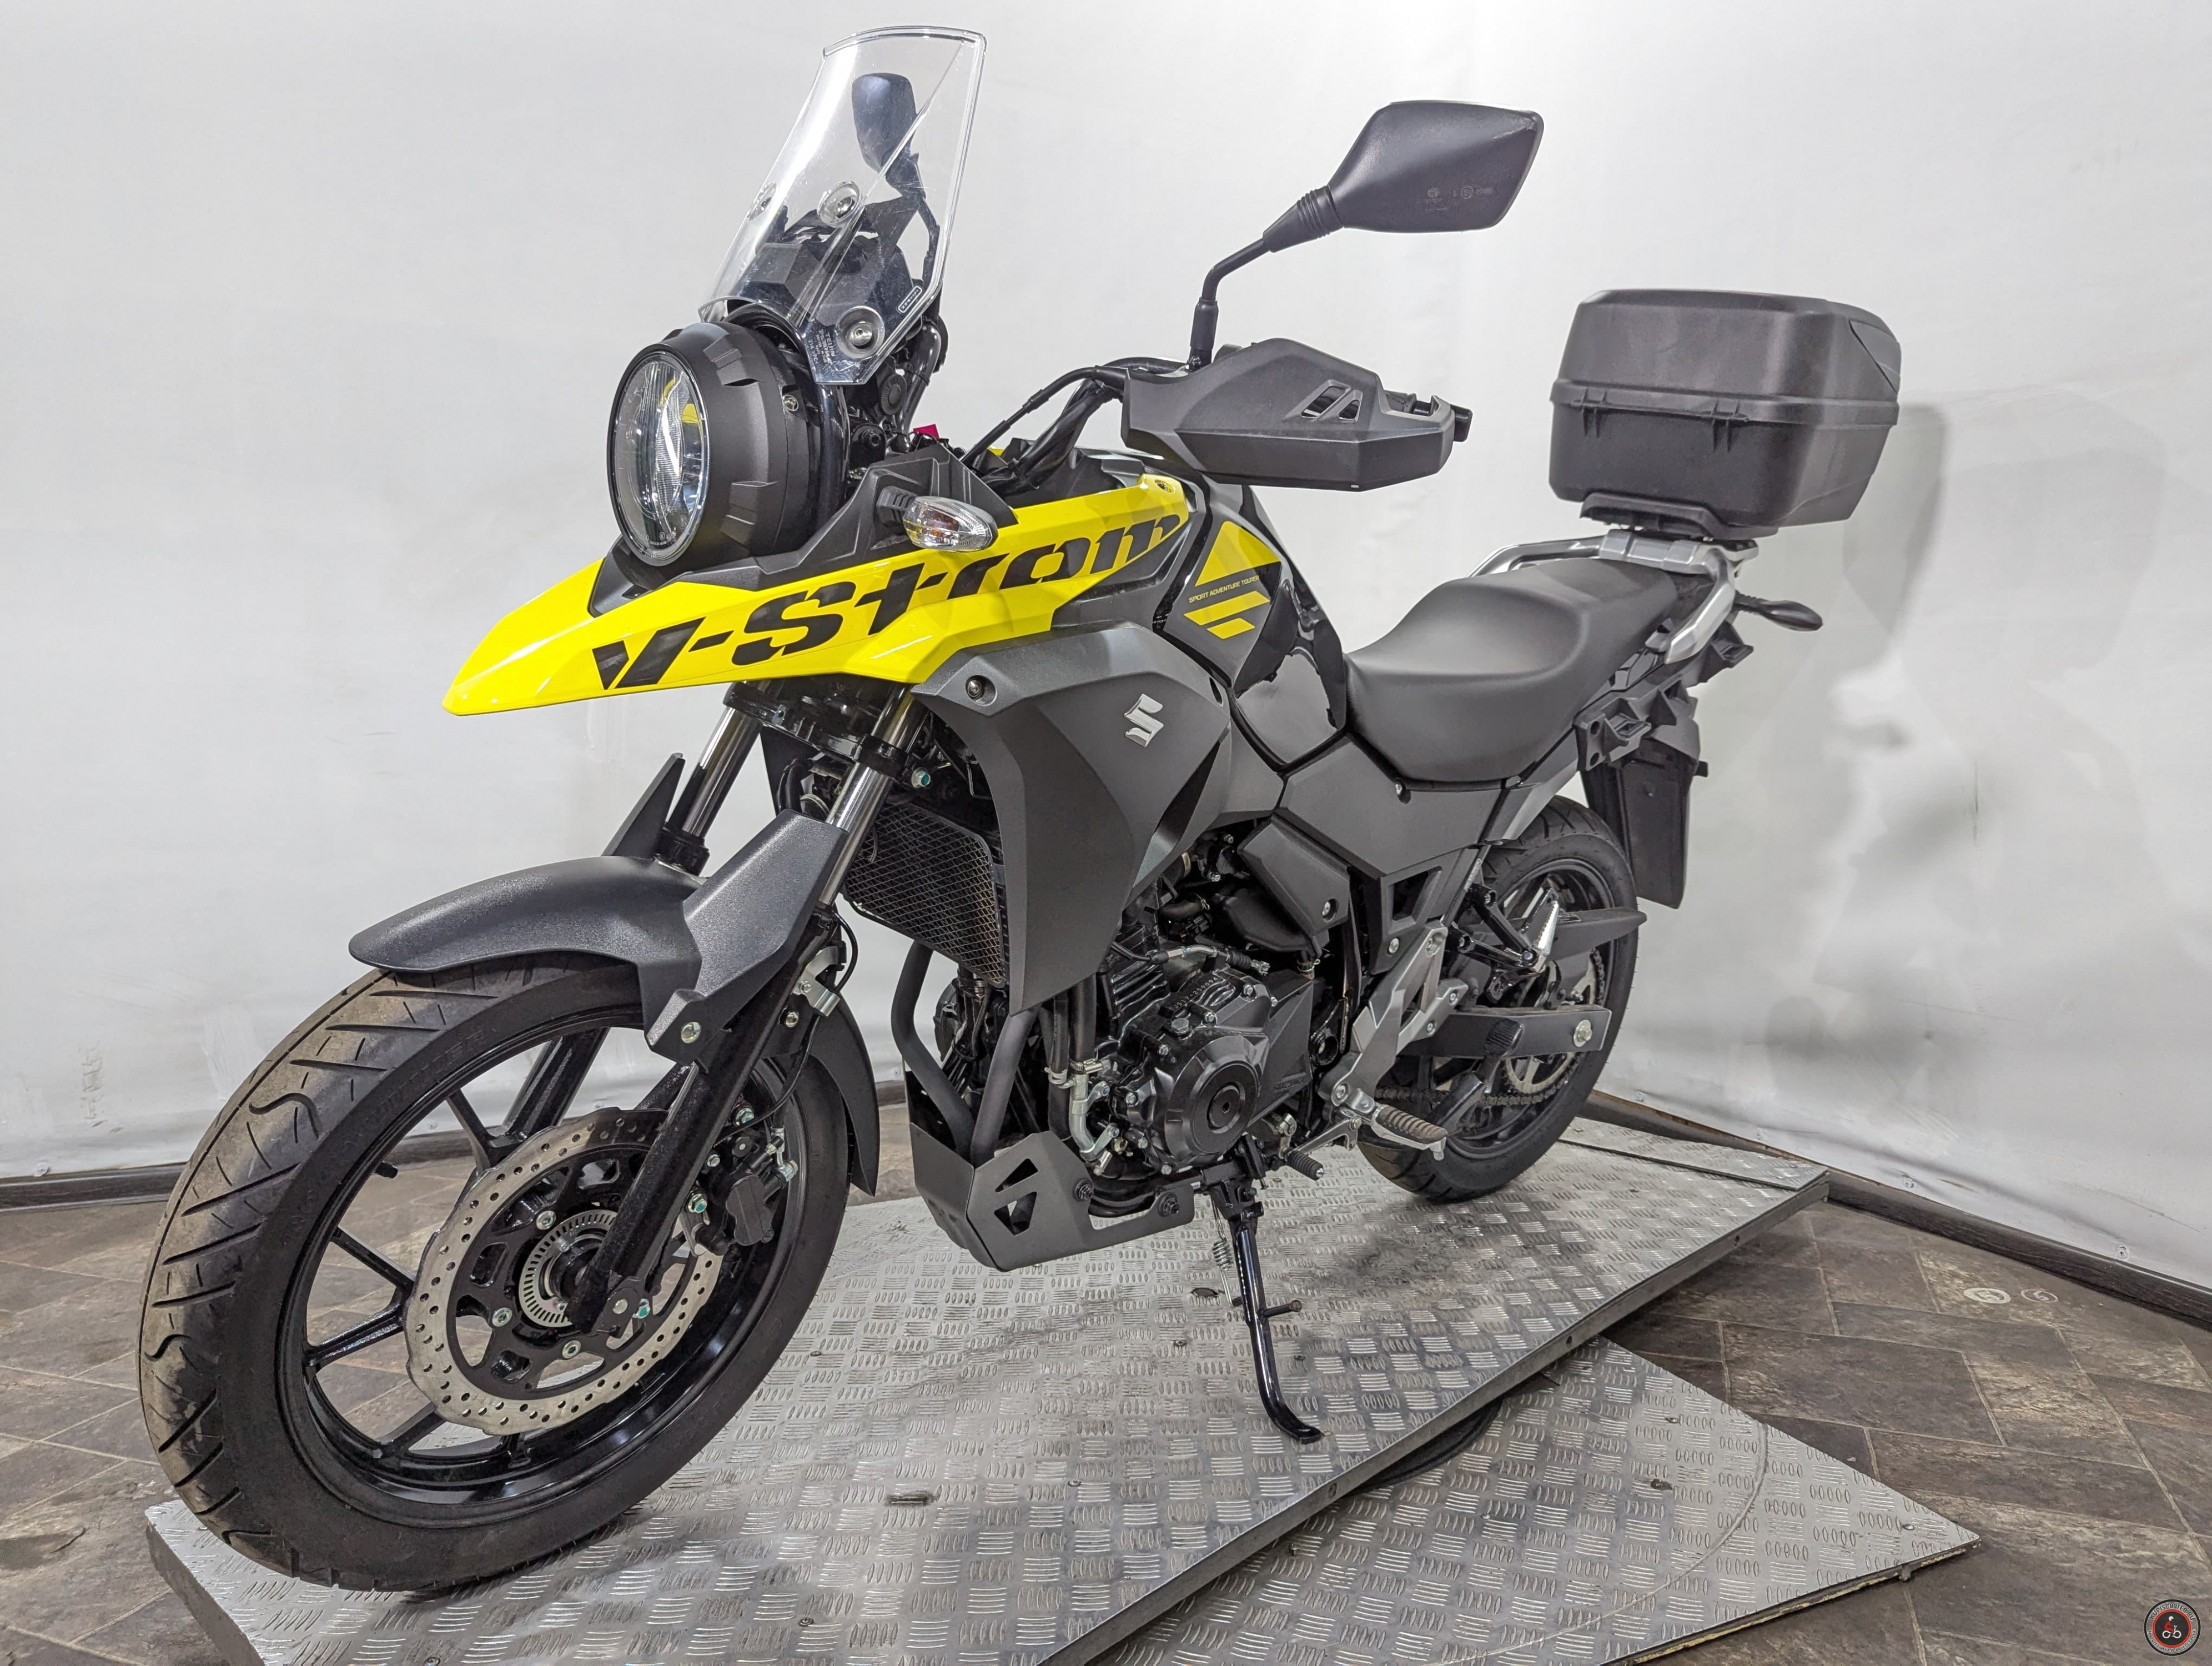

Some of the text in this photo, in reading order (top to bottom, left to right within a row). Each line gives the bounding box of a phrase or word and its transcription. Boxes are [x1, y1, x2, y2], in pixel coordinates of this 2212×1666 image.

[592, 514, 1180, 690] V-Strom
[1189, 575, 1260, 603] SPORT ADVENTURE TOURER
